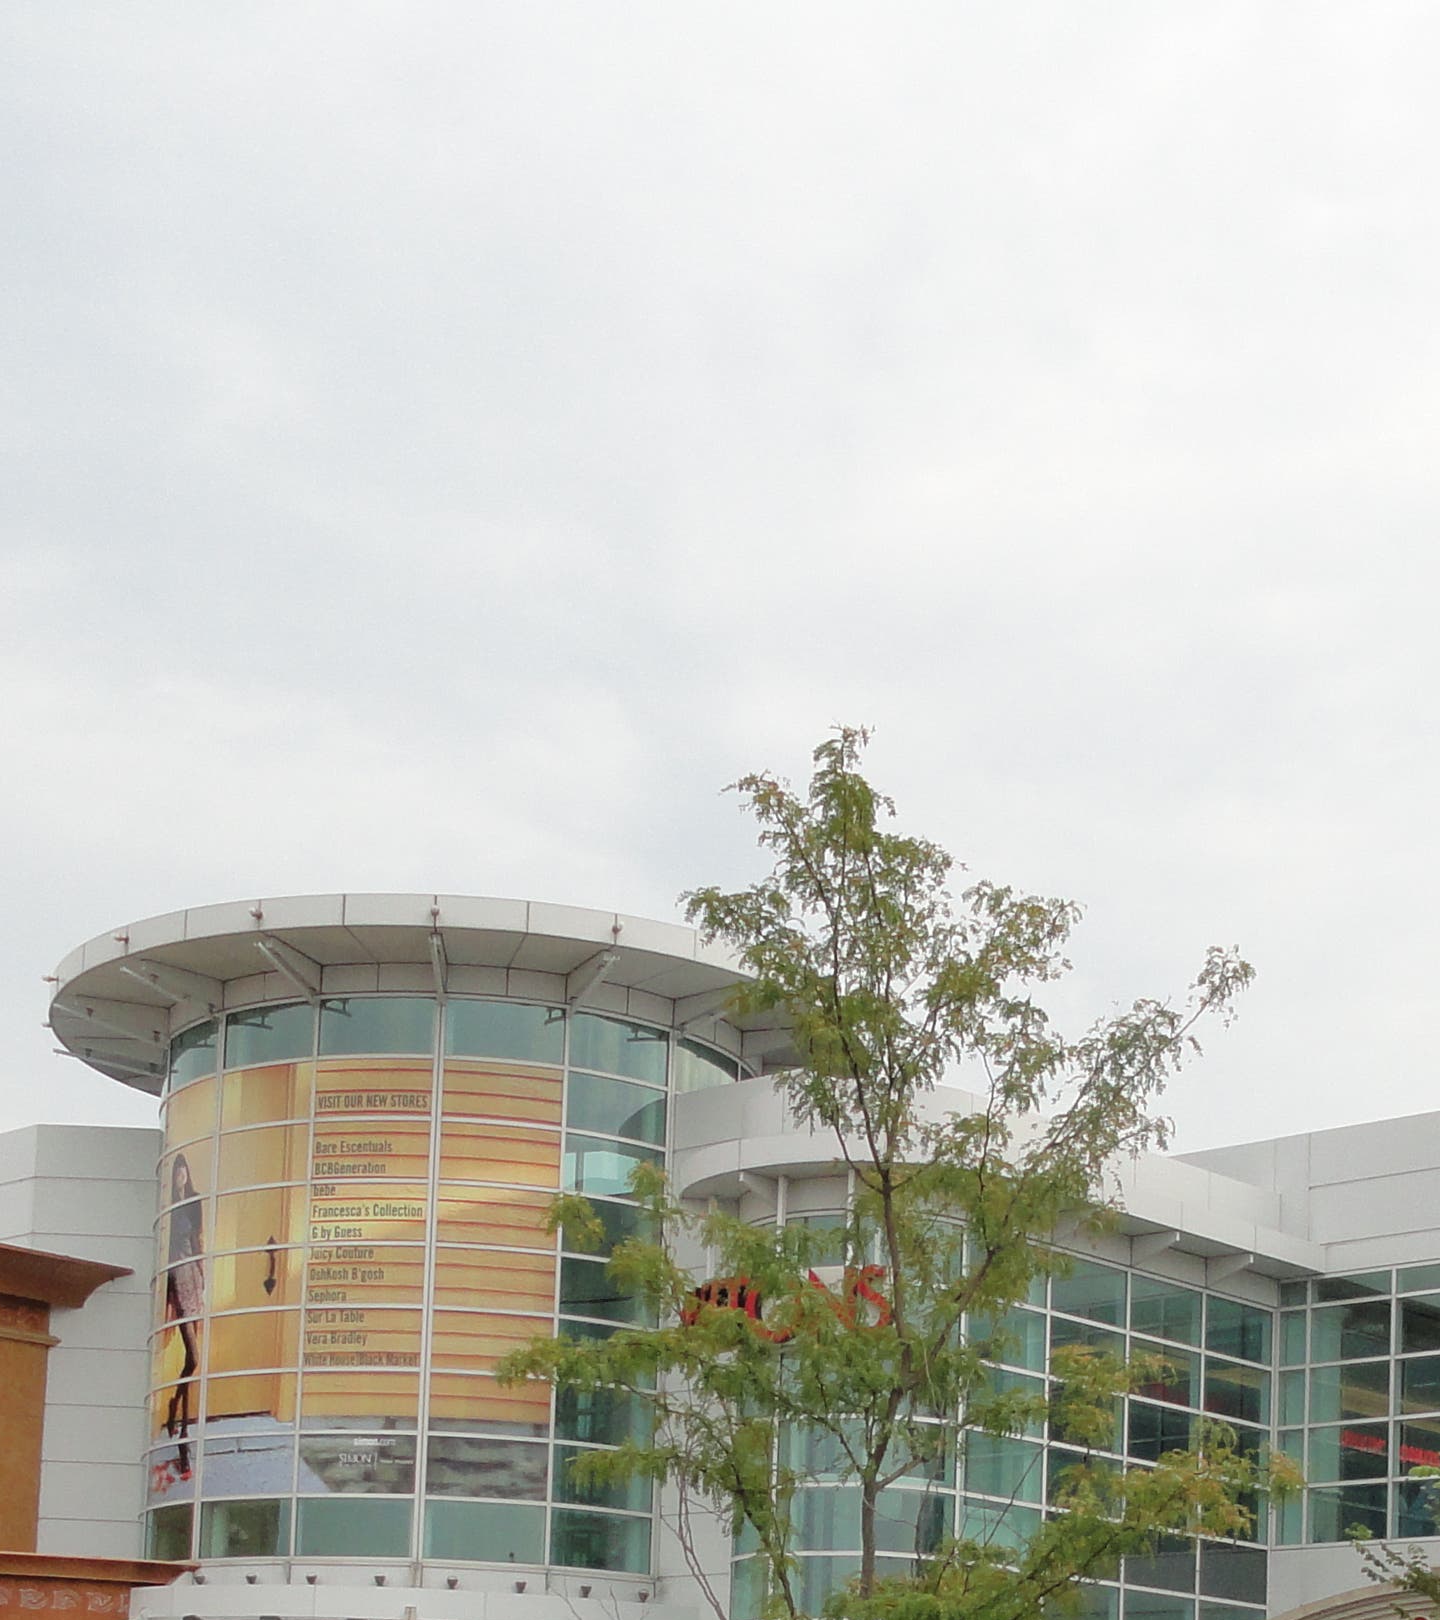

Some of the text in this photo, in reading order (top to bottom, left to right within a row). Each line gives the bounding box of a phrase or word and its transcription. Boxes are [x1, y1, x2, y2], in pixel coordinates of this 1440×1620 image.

[319, 1094, 428, 1109] VISIT OUR NEW STORES
[315, 1140, 393, 1154] Bare Escentuals
[313, 1183, 336, 1197] bebe
[312, 1203, 423, 1218] Francesca's Collection
[320, 1226, 331, 1240] by
[334, 1226, 362, 1238] Guess
[310, 1246, 374, 1261] Juicy Couture
[309, 1289, 347, 1303] Sephora
[307, 1310, 365, 1324] Sur La Table
[306, 1332, 368, 1346] Vera Bradley
